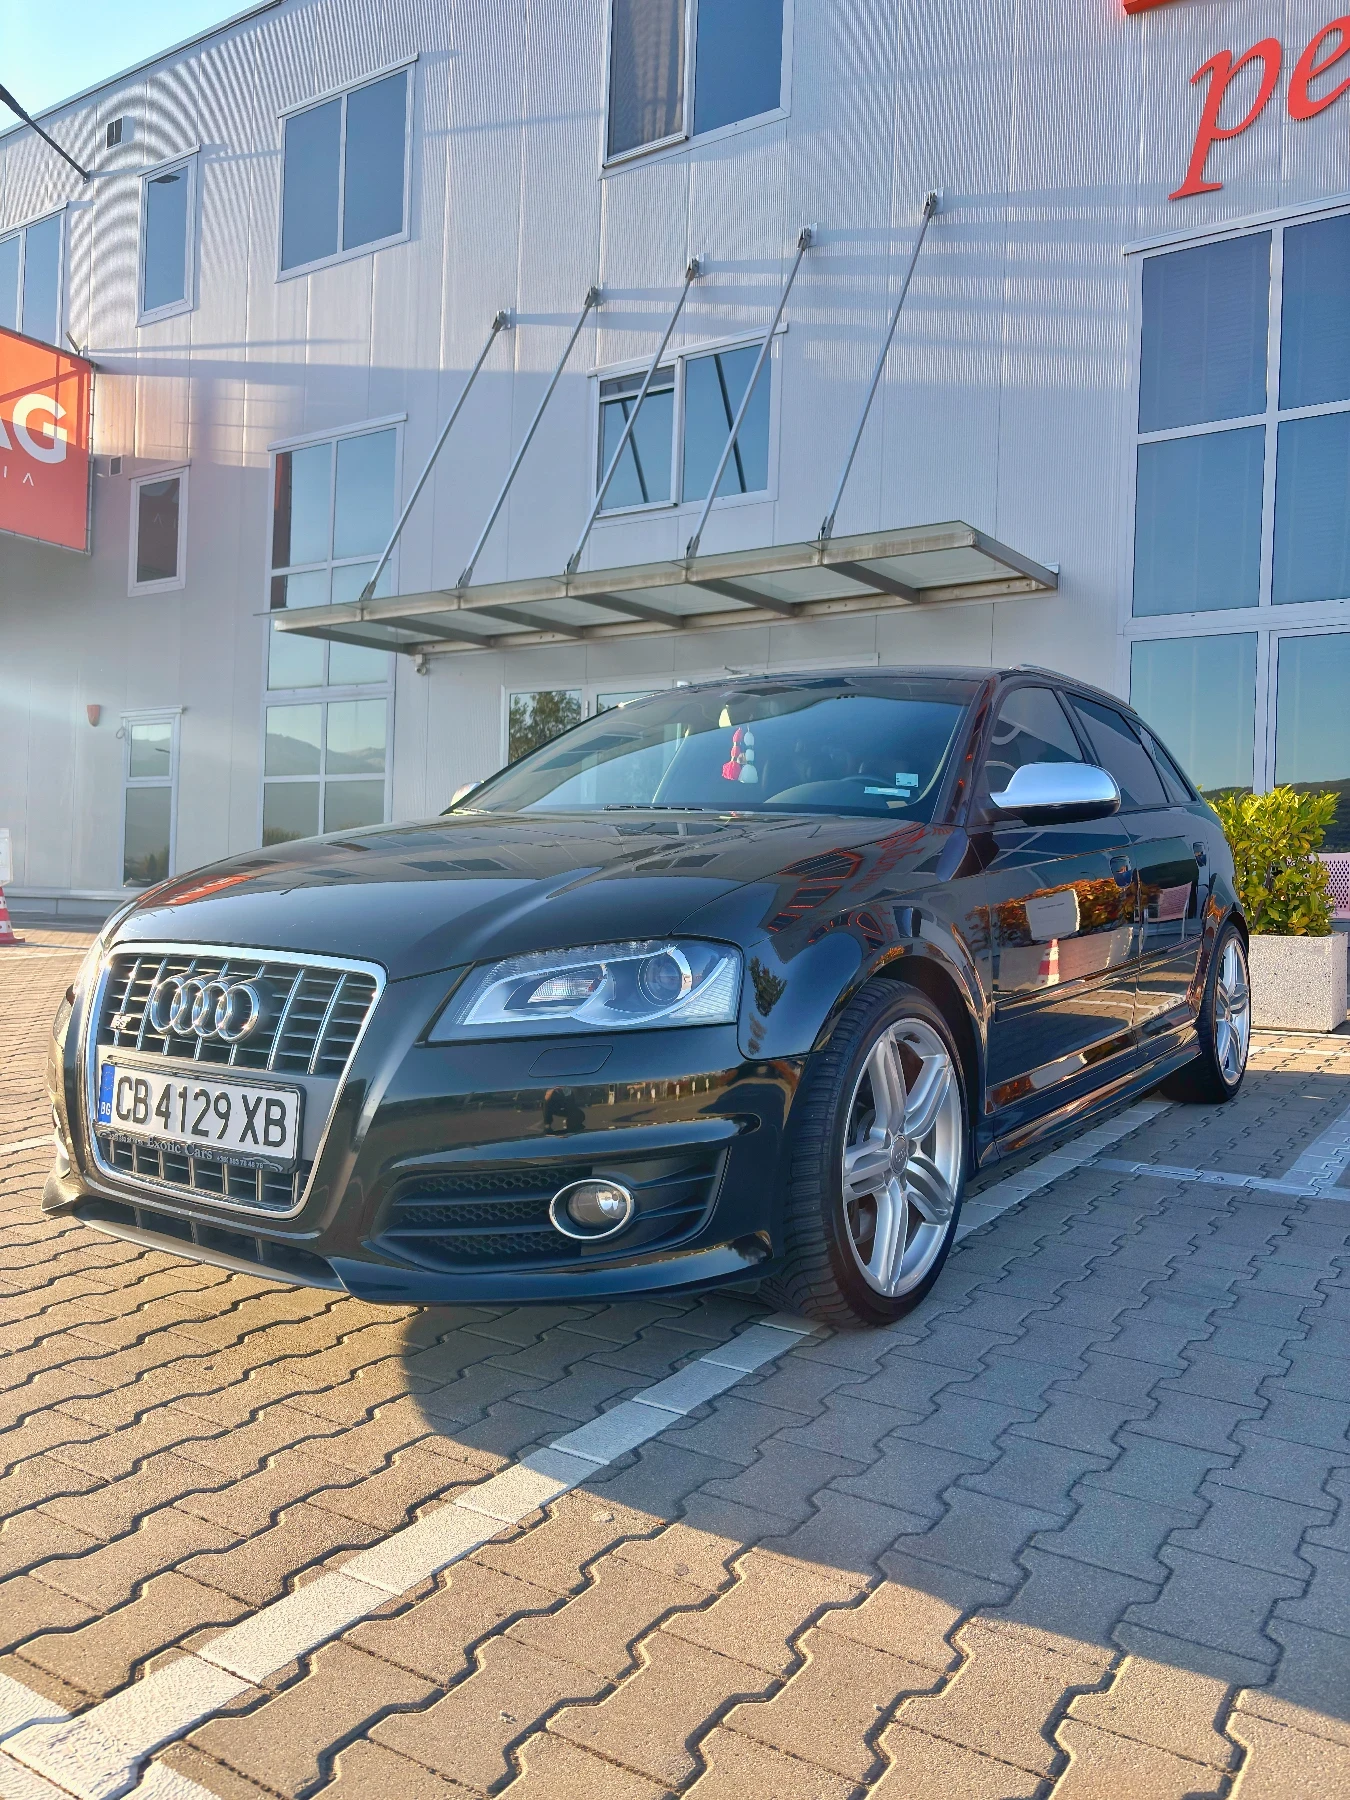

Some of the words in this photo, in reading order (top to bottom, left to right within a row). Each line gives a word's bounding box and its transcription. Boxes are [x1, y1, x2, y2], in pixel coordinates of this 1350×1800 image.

[0, 393, 68, 464] G
[100, 1101, 111, 1115] BG
[116, 1075, 149, 1124] CB
[155, 1083, 231, 1140] 4129
[239, 1094, 287, 1147] XB
[146, 1136, 181, 1155] Exotic
[184, 1144, 213, 1160] Cars
